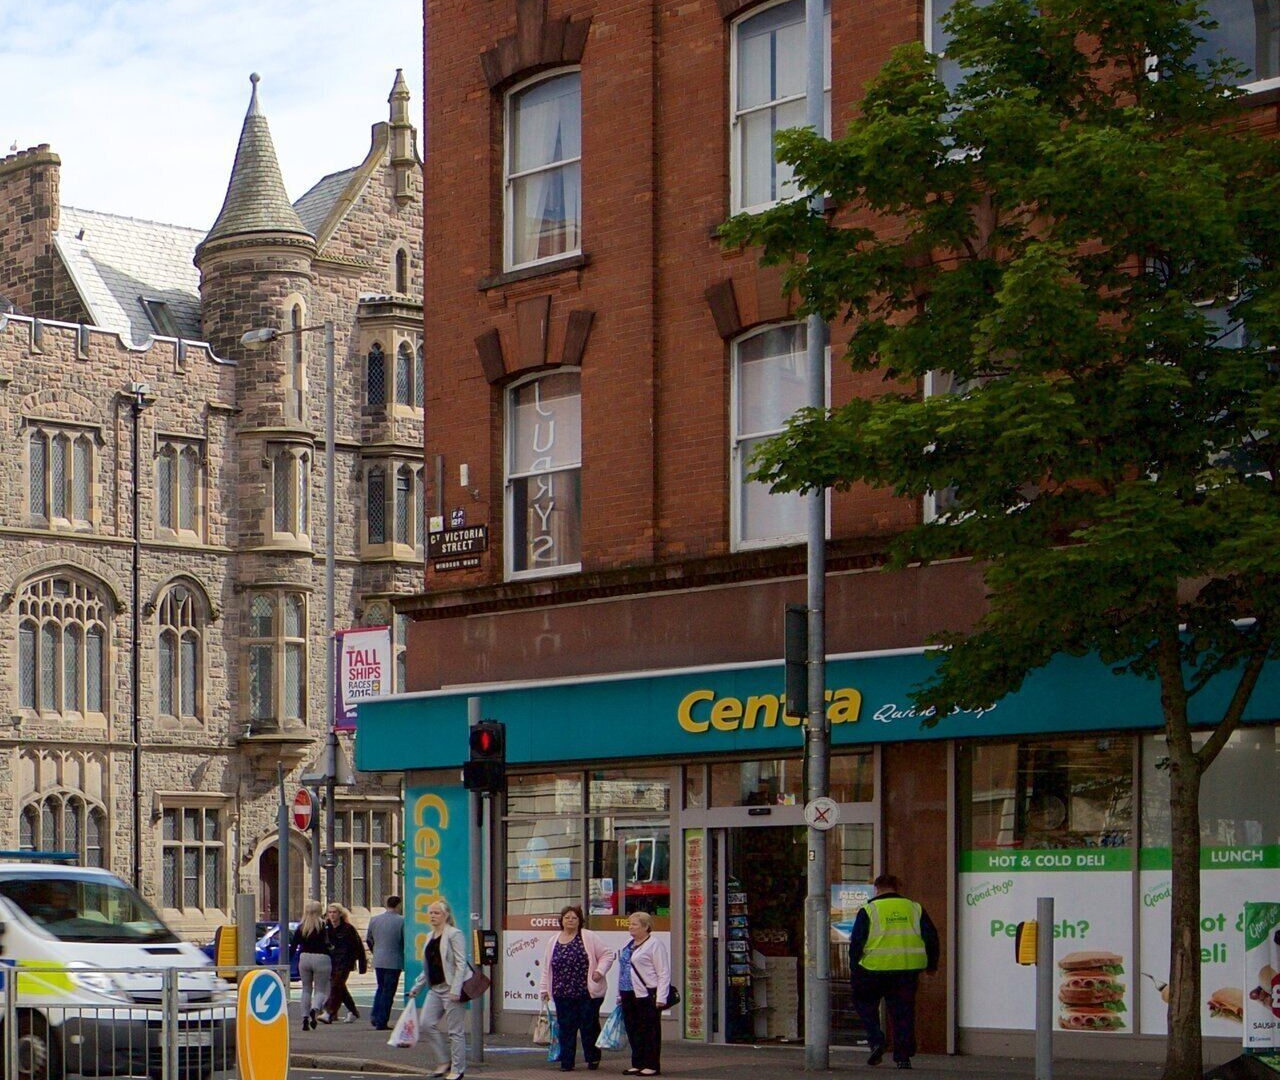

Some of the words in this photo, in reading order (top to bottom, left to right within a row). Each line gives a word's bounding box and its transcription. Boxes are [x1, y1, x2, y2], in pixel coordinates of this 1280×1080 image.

[444, 528, 483, 542] VICTORIA
[442, 540, 473, 553] STREET
[346, 649, 380, 667] TALL
[349, 666, 381, 681] SHIPS
[348, 680, 371, 689] RACES
[989, 856, 1017, 867] HOT
[1021, 855, 1031, 867] &
[1035, 855, 1072, 867] COLD
[1076, 855, 1105, 866] DELI
[1211, 850, 1264, 863] LUNCH
[990, 920, 1090, 939] Pesh?
[1201, 913, 1227, 932] ot
[1200, 943, 1227, 963] eli
[504, 991, 522, 1000] Pick
[524, 992, 539, 1000] me
